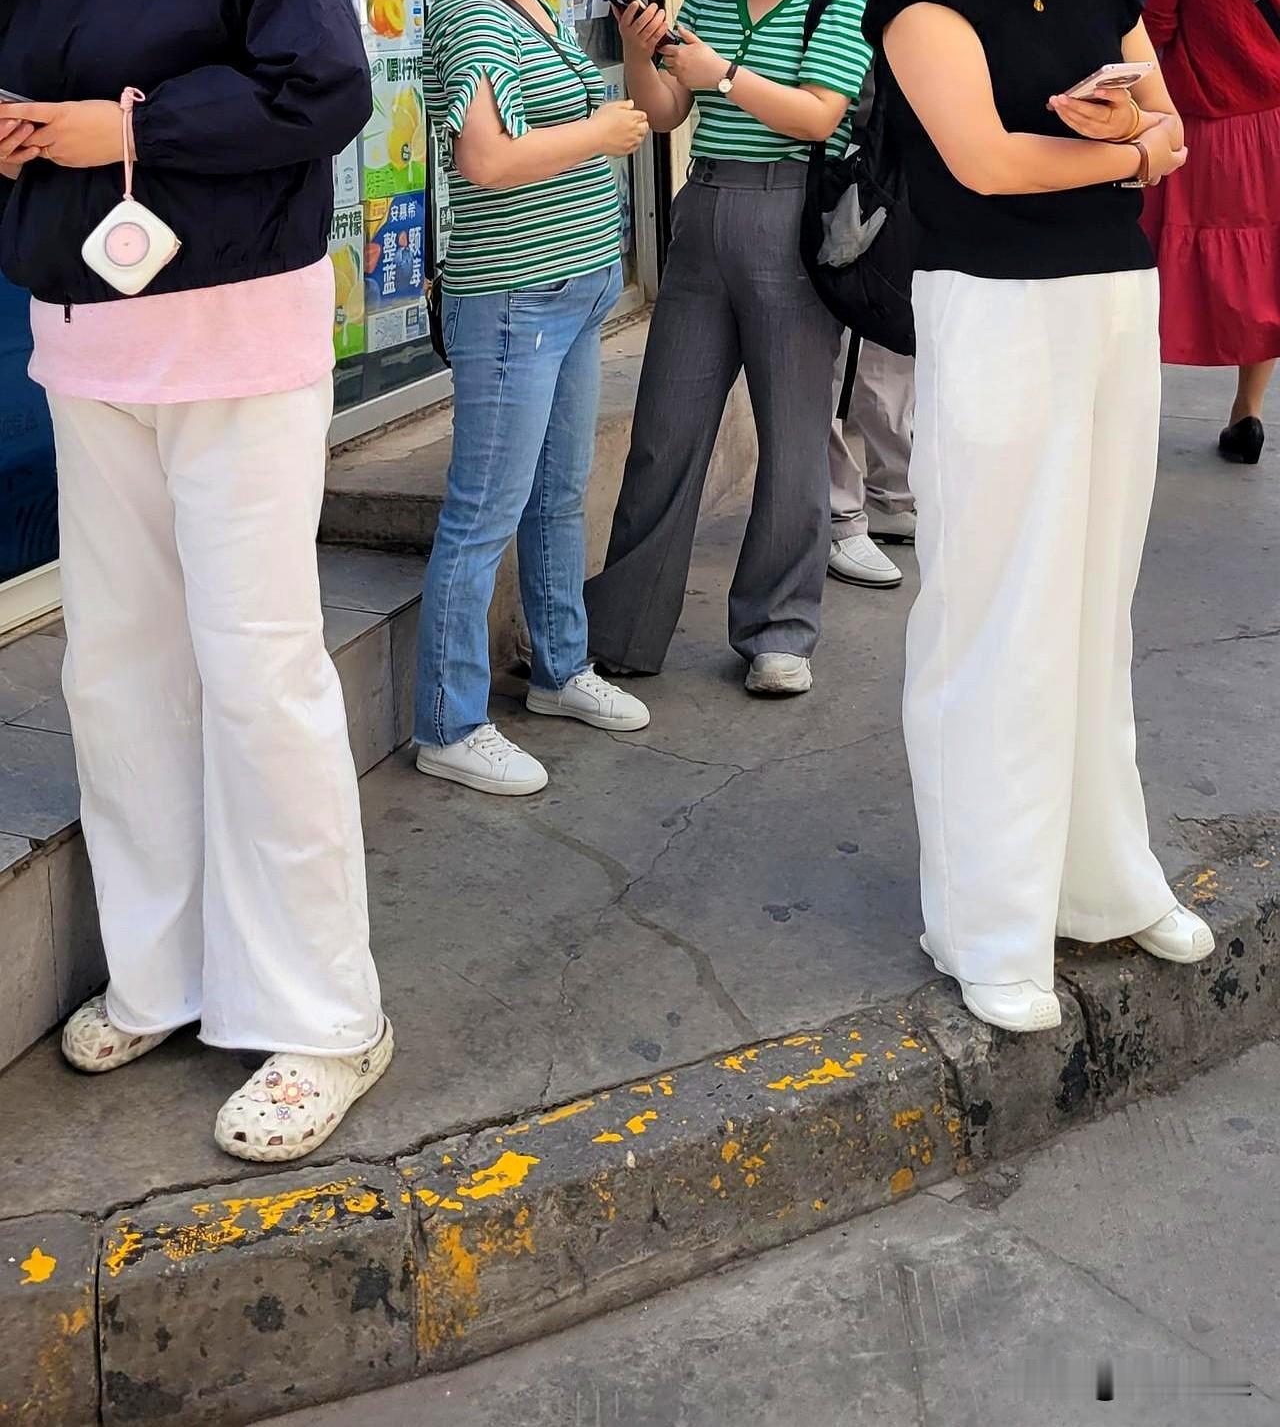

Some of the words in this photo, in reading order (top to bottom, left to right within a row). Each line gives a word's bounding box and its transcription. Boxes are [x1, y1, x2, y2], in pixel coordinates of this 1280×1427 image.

[390, 200, 417, 223] 安慕希
[328, 210, 362, 241] !柠檬
